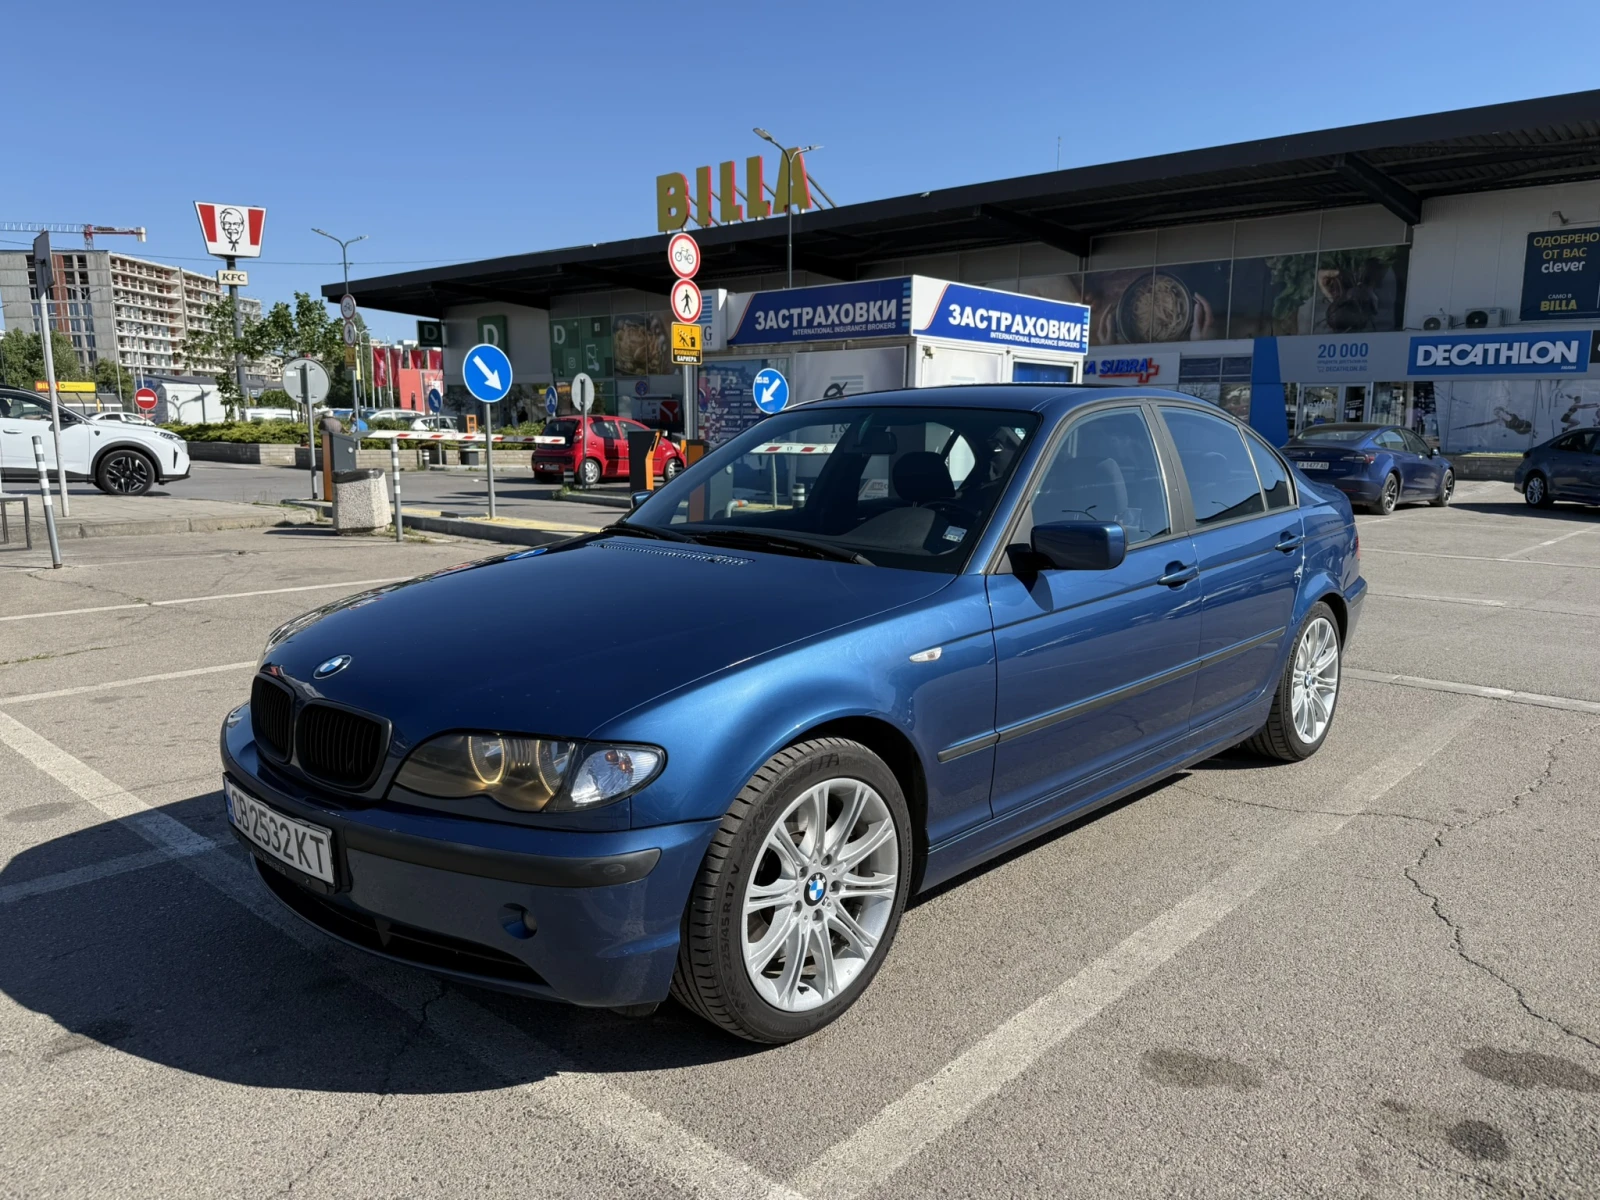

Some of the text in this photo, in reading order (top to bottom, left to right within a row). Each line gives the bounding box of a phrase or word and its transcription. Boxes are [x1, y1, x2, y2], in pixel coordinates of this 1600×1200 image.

[656, 146, 812, 233] BILLA
[1533, 232, 1600, 248] ОДОБРЕНО
[1543, 247, 1587, 260] ОТ ВАС
[1541, 261, 1586, 273] clever
[221, 273, 245, 282] KFC
[1540, 299, 1577, 311] BILLA
[754, 299, 897, 331] ЗАСТРАХОВКИ
[948, 303, 1082, 341] ЗАСТРАХОВКИ
[423, 324, 438, 341] D
[553, 325, 566, 345] D
[792, 321, 896, 336] INTERNATIONAL INSURANCE BROKERS
[990, 331, 1080, 349] INTERNATIONAL INSURANCE BROKERS
[1317, 342, 1369, 358] 20 000
[1416, 340, 1580, 367] DECATHLON
[1100, 358, 1148, 374] SUBRA
